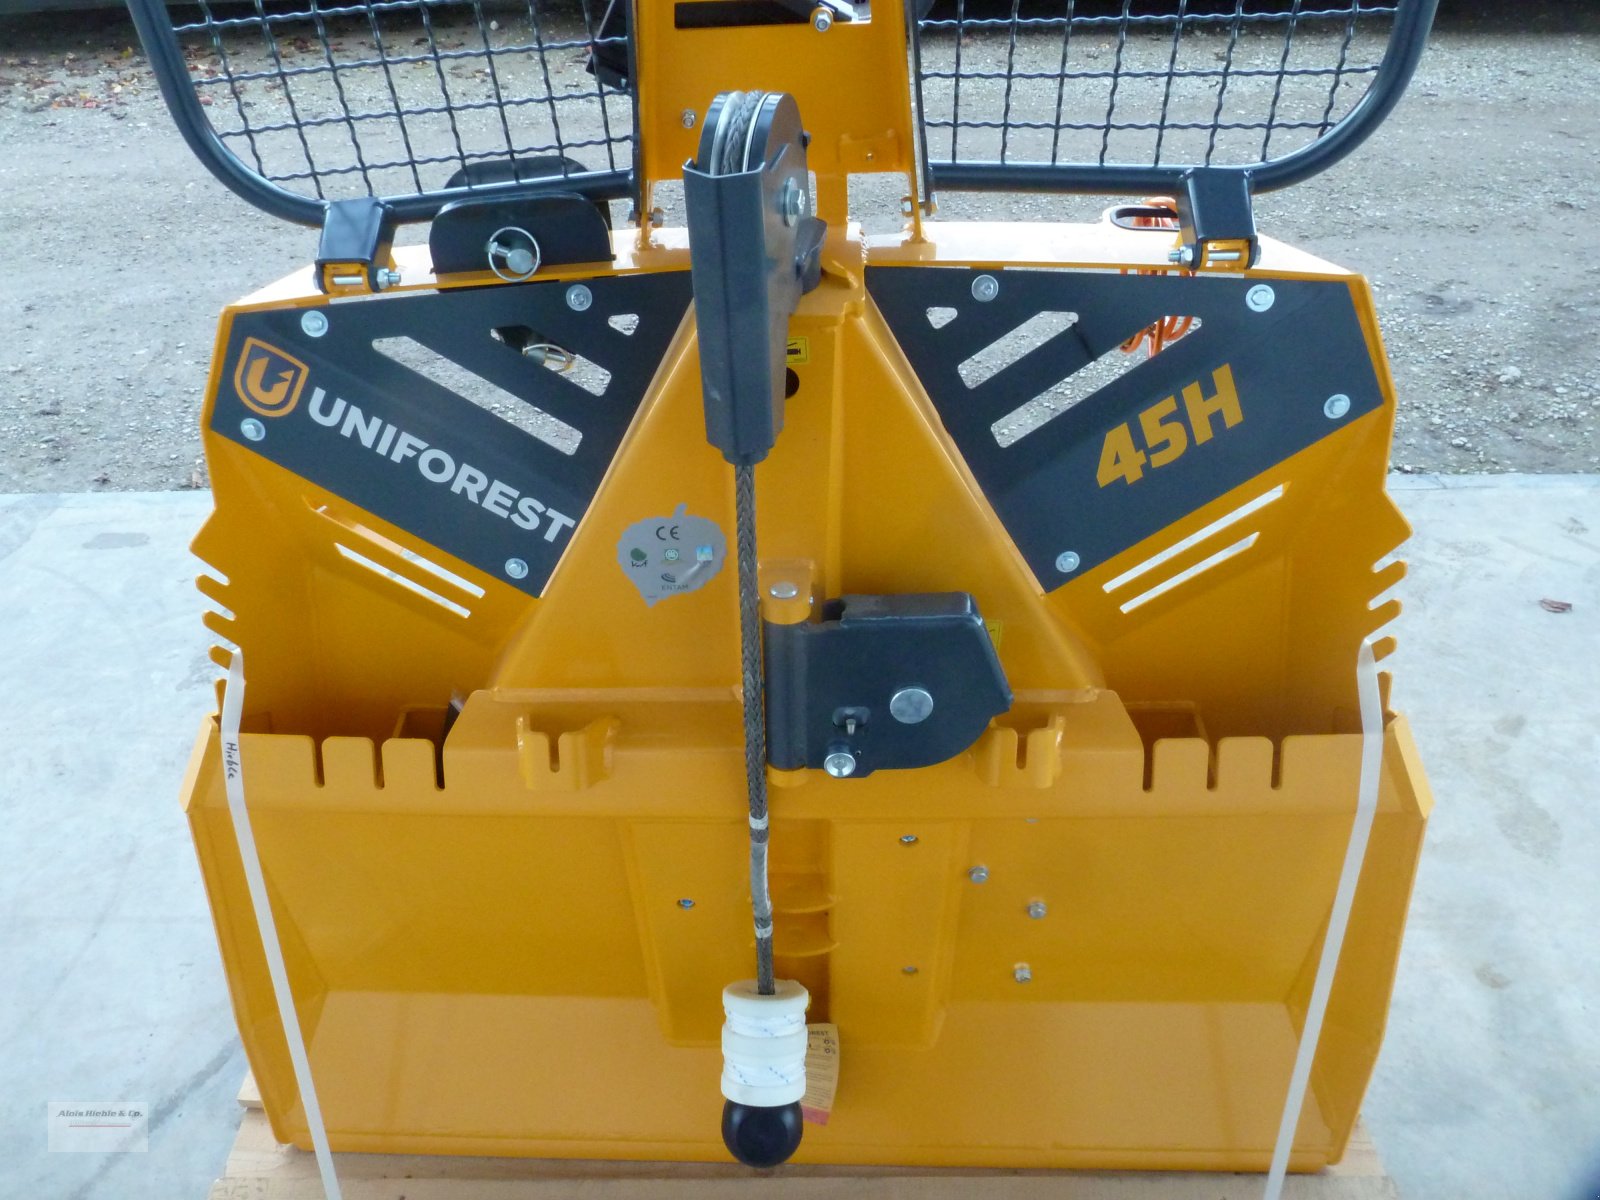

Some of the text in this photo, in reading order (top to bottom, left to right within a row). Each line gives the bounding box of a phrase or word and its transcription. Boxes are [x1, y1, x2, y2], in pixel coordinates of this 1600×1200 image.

[308, 386, 576, 543] UNIFOREST
[1096, 363, 1244, 488] 45H
[655, 525, 680, 541] CE
